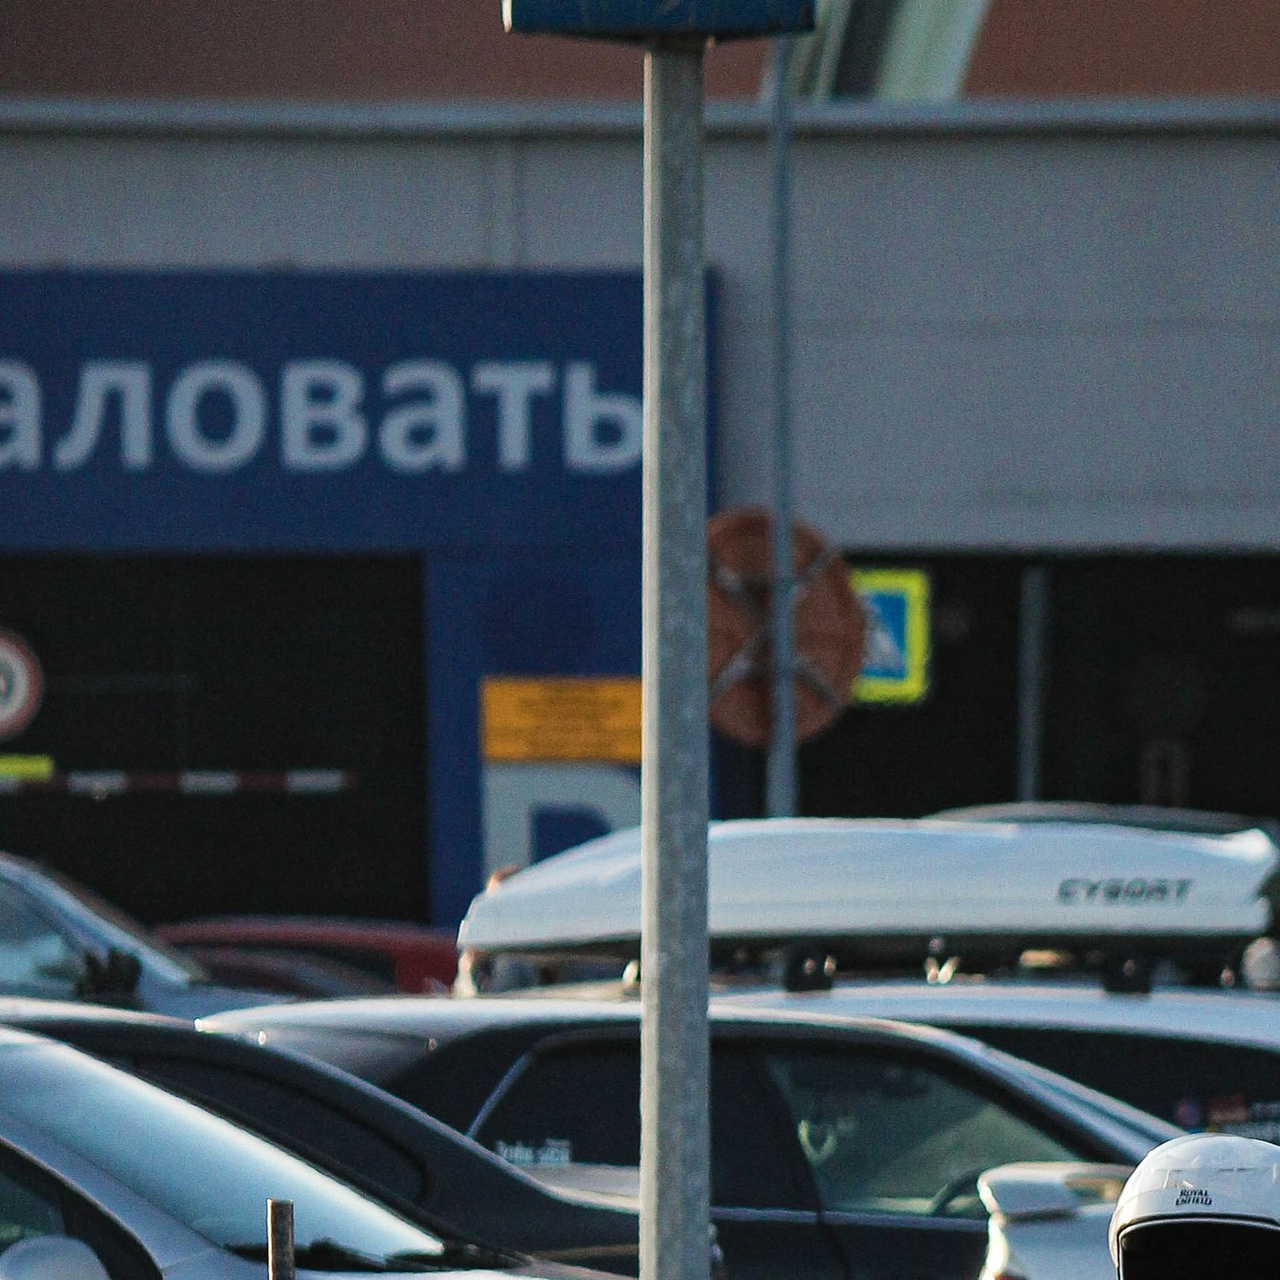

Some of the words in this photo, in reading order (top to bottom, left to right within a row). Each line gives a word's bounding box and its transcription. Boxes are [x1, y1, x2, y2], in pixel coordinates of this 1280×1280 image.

[0, 358, 643, 473] аловать
[1179, 1188, 1209, 1197] ROYAL
[1175, 1196, 1213, 1206] ENFIELD
